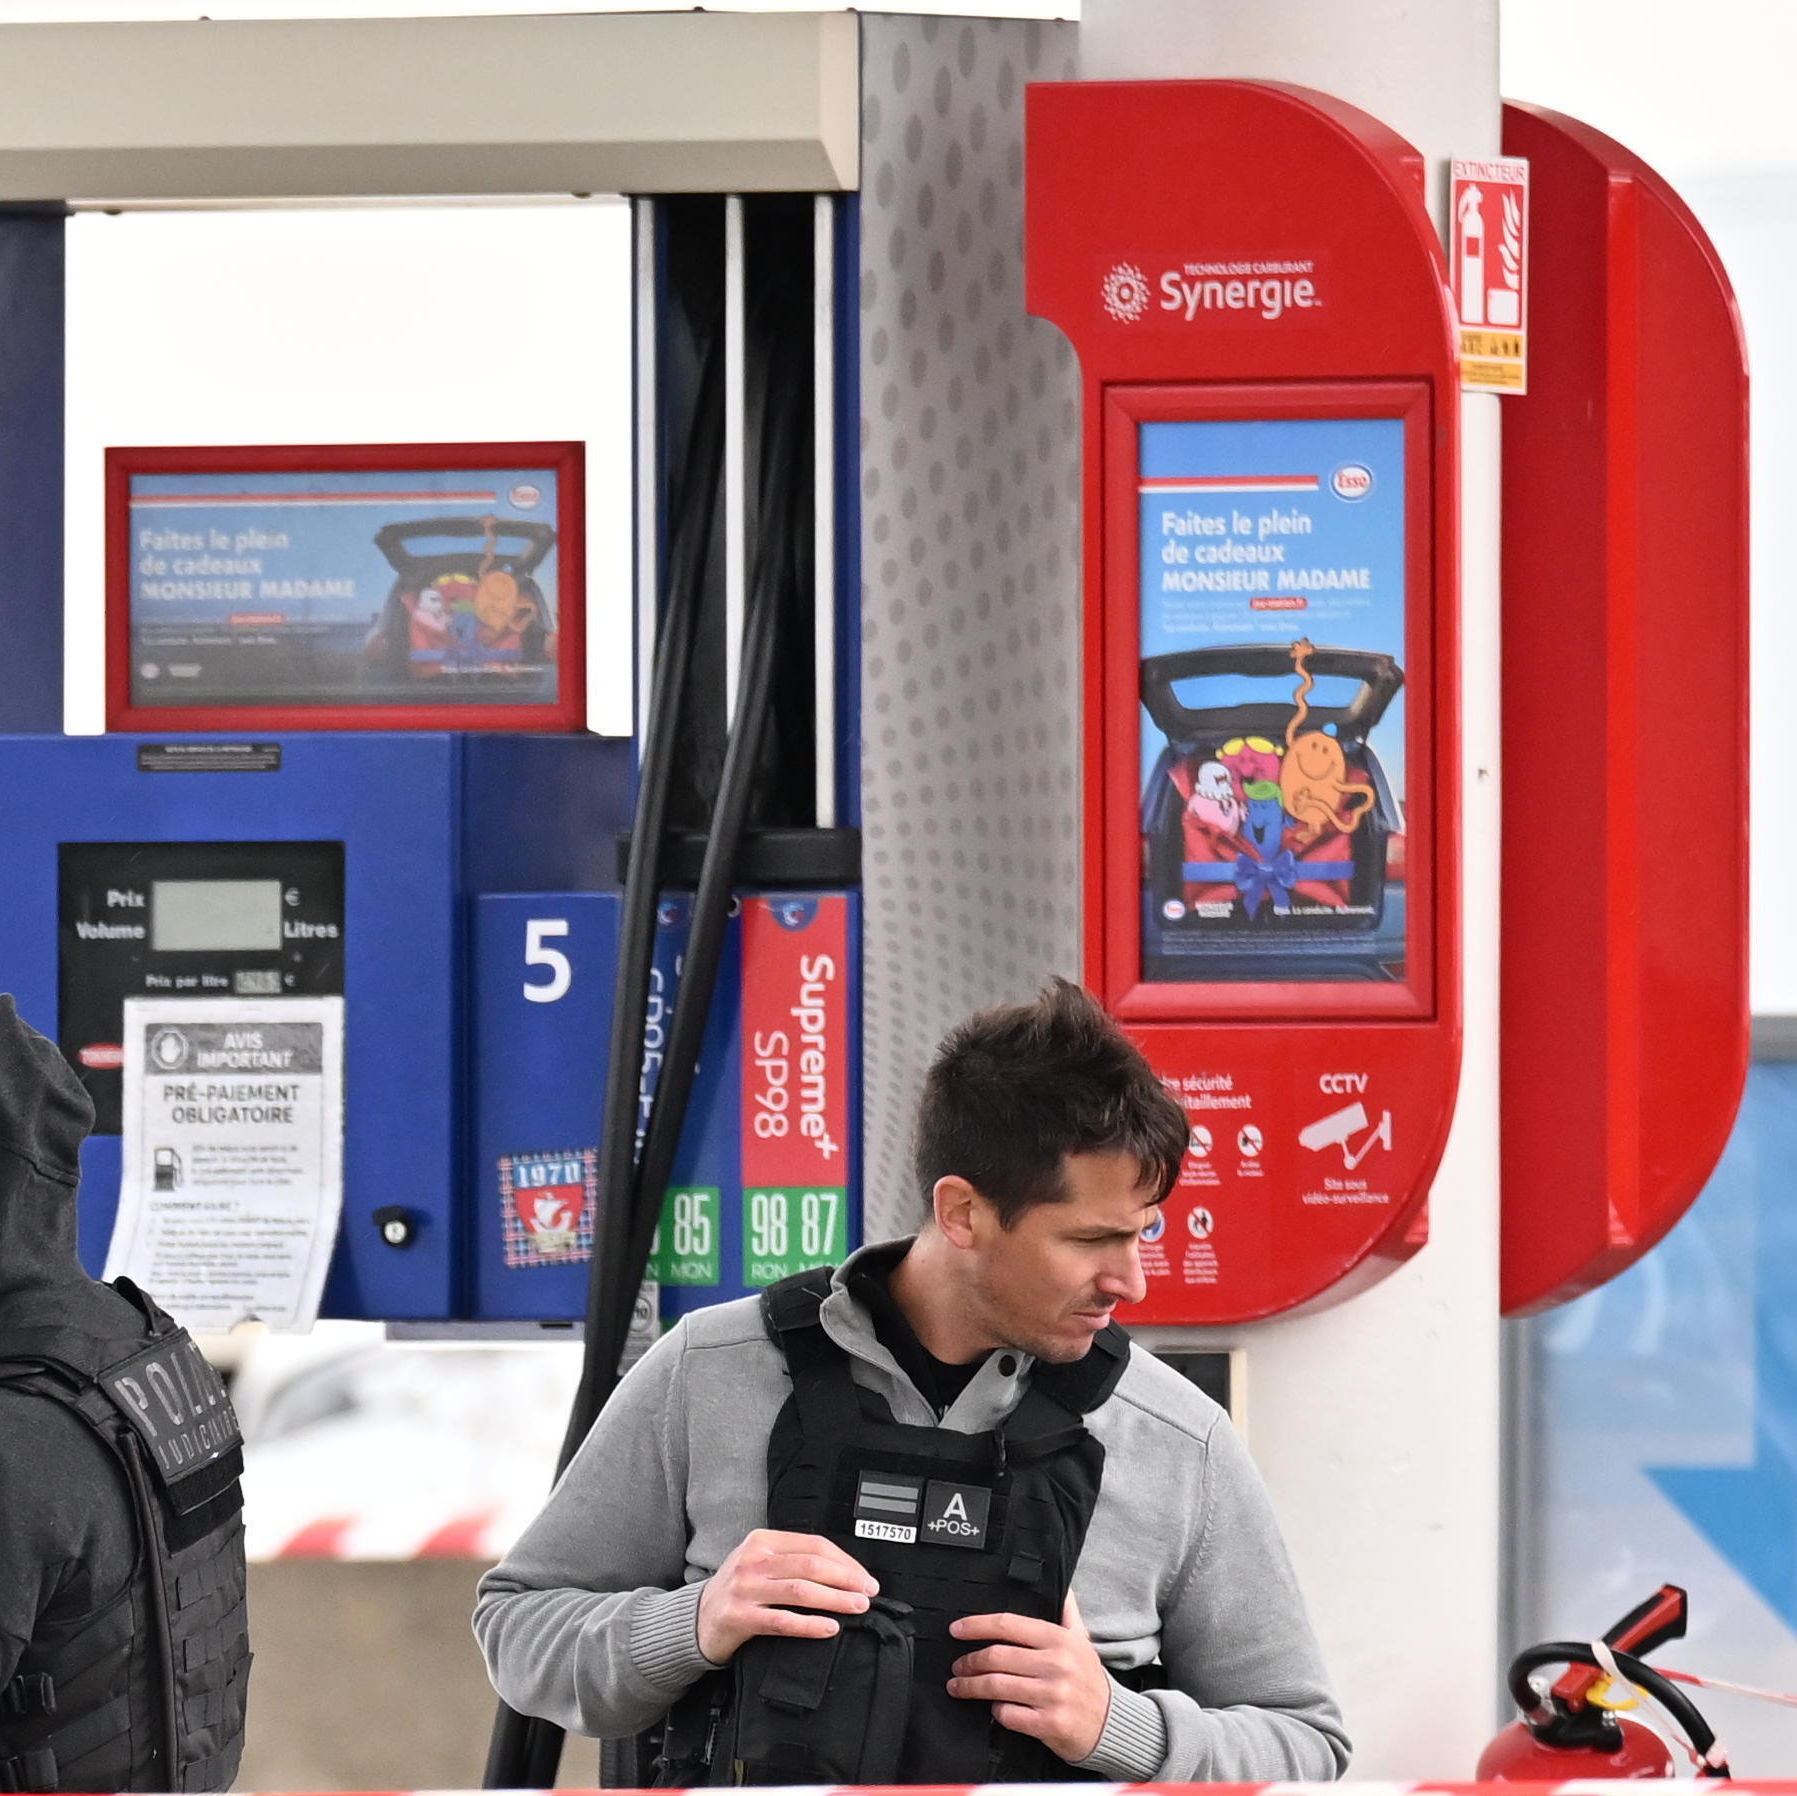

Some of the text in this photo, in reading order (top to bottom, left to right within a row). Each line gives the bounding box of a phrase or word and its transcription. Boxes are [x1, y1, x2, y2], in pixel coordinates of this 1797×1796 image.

[1453, 160, 1525, 181] EXTINCTEUR
[1159, 271, 1316, 320] Synergie
[1161, 508, 1312, 540] Faites le plein
[139, 527, 289, 554] Faites le plein
[1161, 539, 1285, 564] de cadeaux
[139, 553, 262, 576] de cadeaux
[139, 579, 355, 600] MONSIEUR MADAME
[1161, 568, 1371, 592] MONSIEUR MADAME
[107, 887, 301, 908] Prix €
[76, 920, 339, 940] Volume Litres
[522, 917, 573, 1004] 5
[145, 974, 172, 988] Prix
[175, 975, 199, 990] par
[201, 974, 229, 988] litre
[223, 1031, 264, 1049] AVIS
[196, 1050, 294, 1069] IMPORTANT
[163, 1081, 301, 1102] PRÉ-PAIEMENT
[753, 1029, 791, 1139] SP98
[1182, 1072, 1235, 1092] sécurité
[1319, 1072, 1369, 1094] CCTV
[171, 1106, 295, 1124] OBLIGATOIRE
[518, 1160, 582, 1189] 1970
[673, 1192, 712, 1257] 85
[750, 1192, 839, 1258] 98 87
[670, 1262, 713, 1279] MON
[750, 1262, 789, 1280] RON
[943, 1491, 969, 1521] A
[859, 1522, 912, 1541] 1517570
